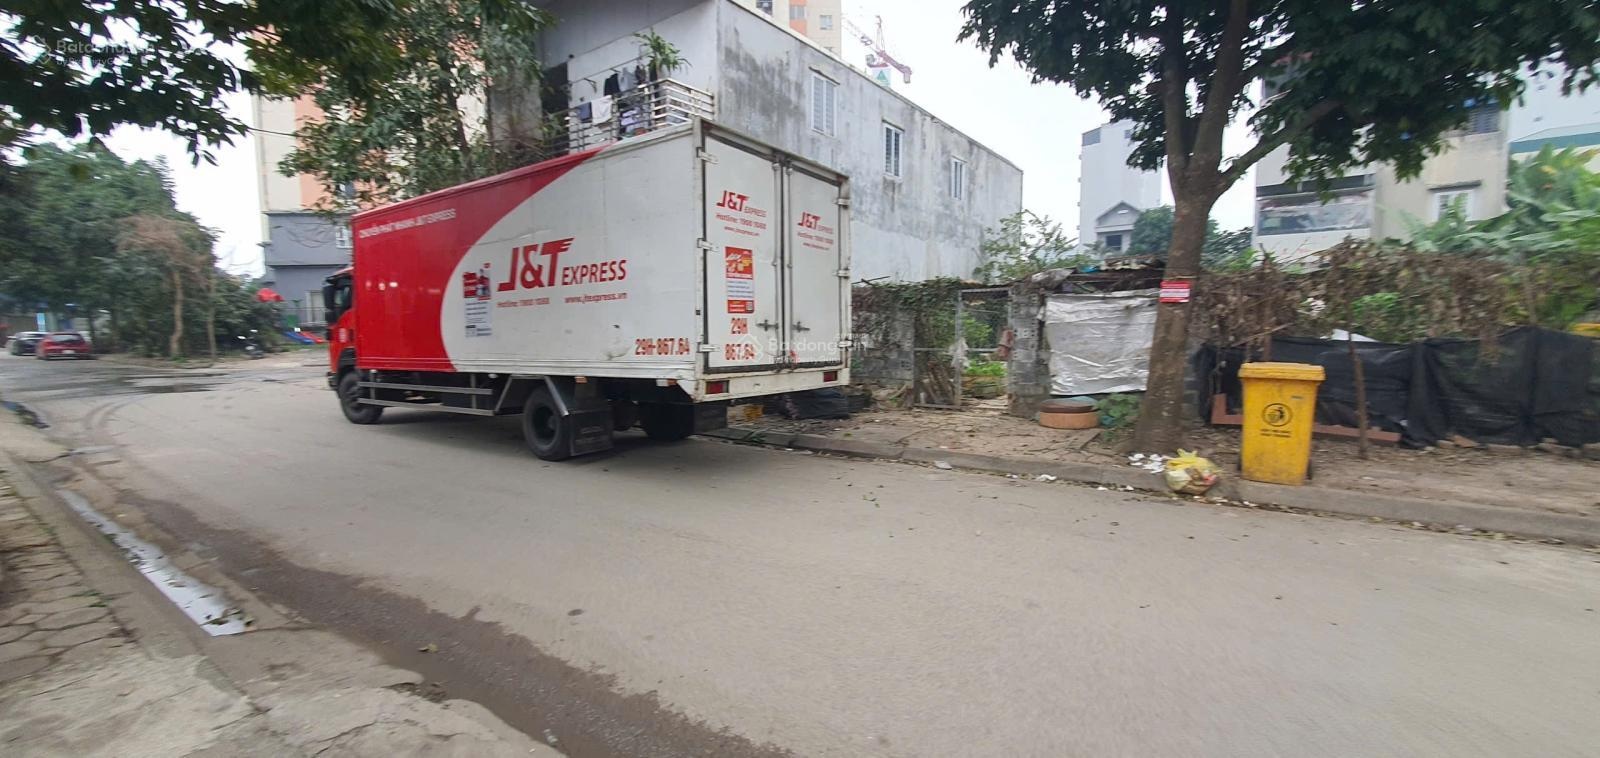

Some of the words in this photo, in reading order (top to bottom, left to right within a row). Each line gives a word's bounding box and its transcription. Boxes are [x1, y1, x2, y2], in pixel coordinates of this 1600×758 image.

[716, 190, 749, 211] J&T
[797, 211, 820, 230] J&T
[497, 237, 574, 292] J&T
[562, 260, 627, 286] EXPRESS
[730, 317, 748, 335] 29H
